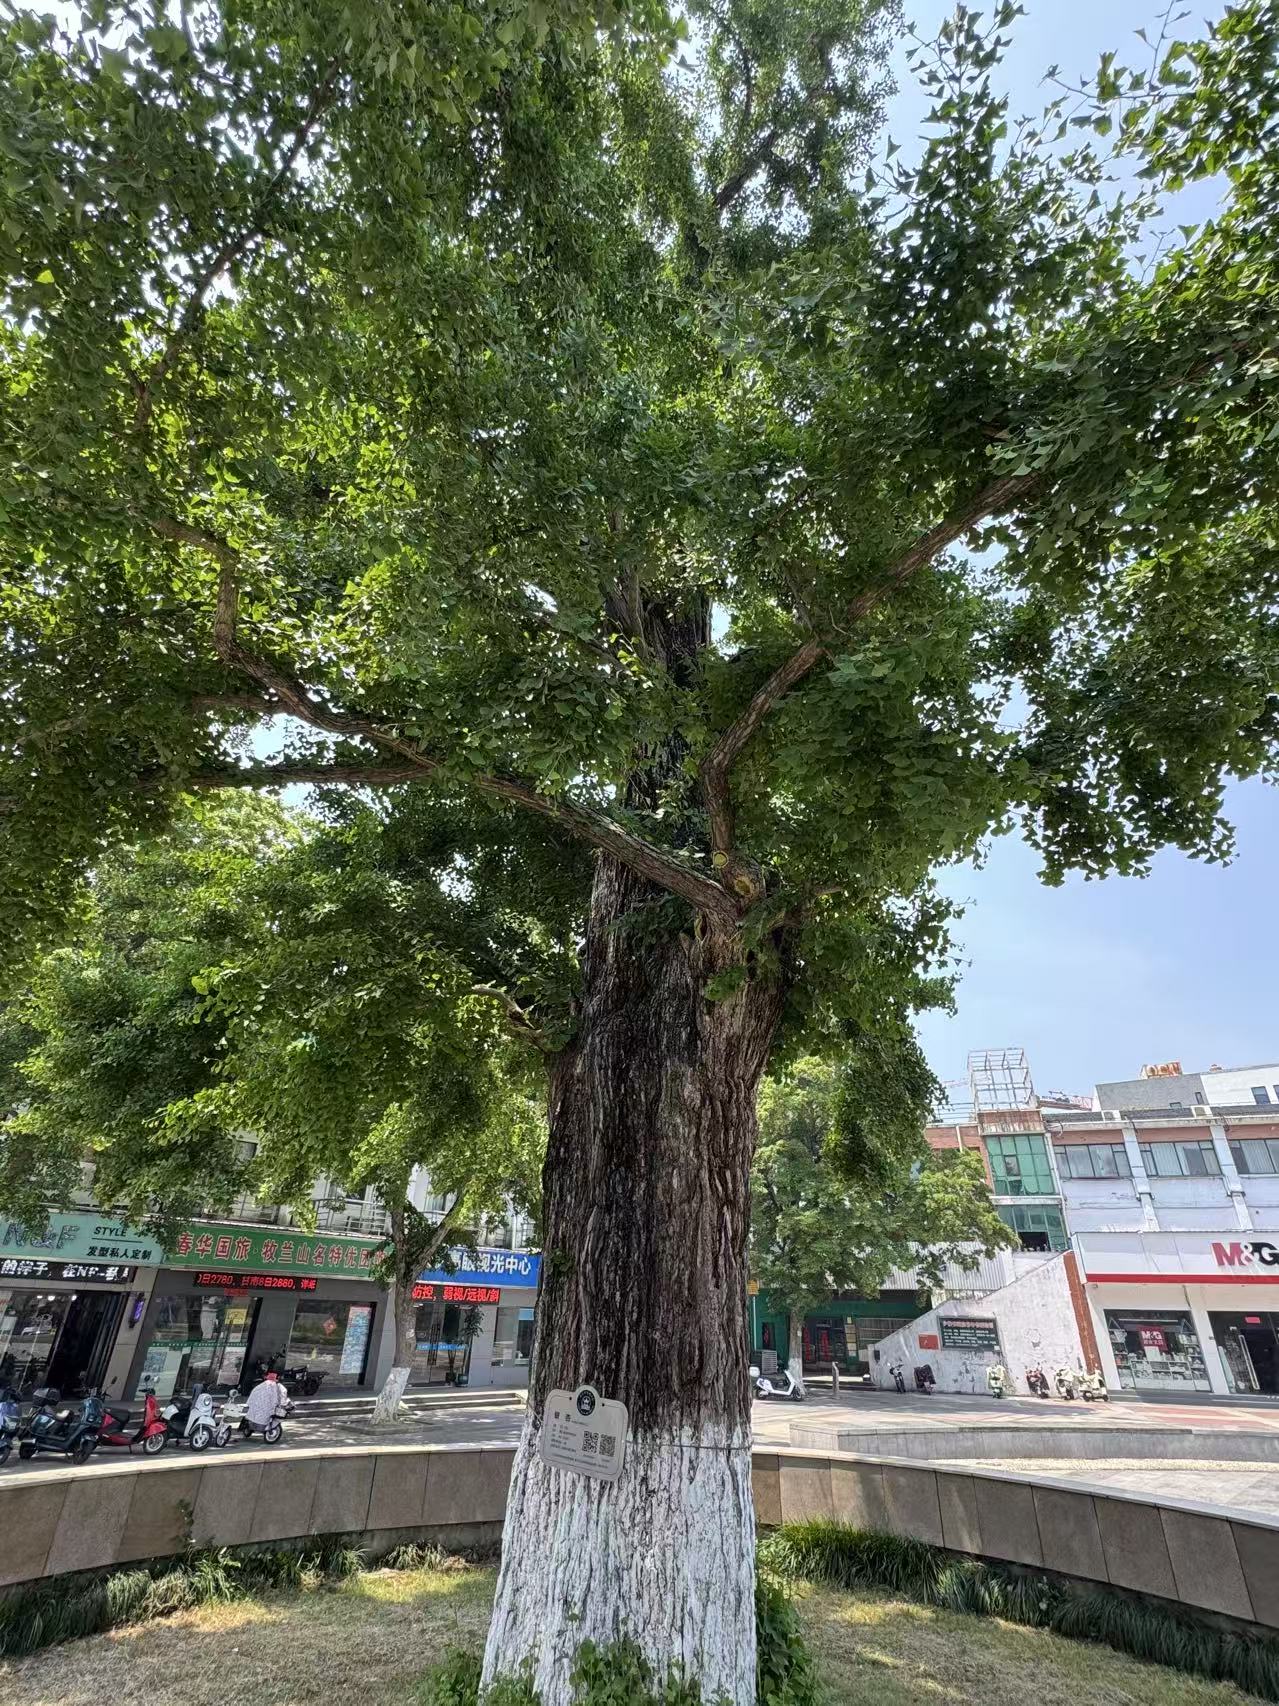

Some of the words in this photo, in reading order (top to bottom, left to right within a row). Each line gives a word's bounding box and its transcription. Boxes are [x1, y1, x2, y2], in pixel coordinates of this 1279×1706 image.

[94, 1226, 126, 1238] STYLE
[86, 1245, 152, 1261] 发型私人定制
[1211, 1241, 1279, 1266] M&G
[1141, 1330, 1162, 1340] M&G
